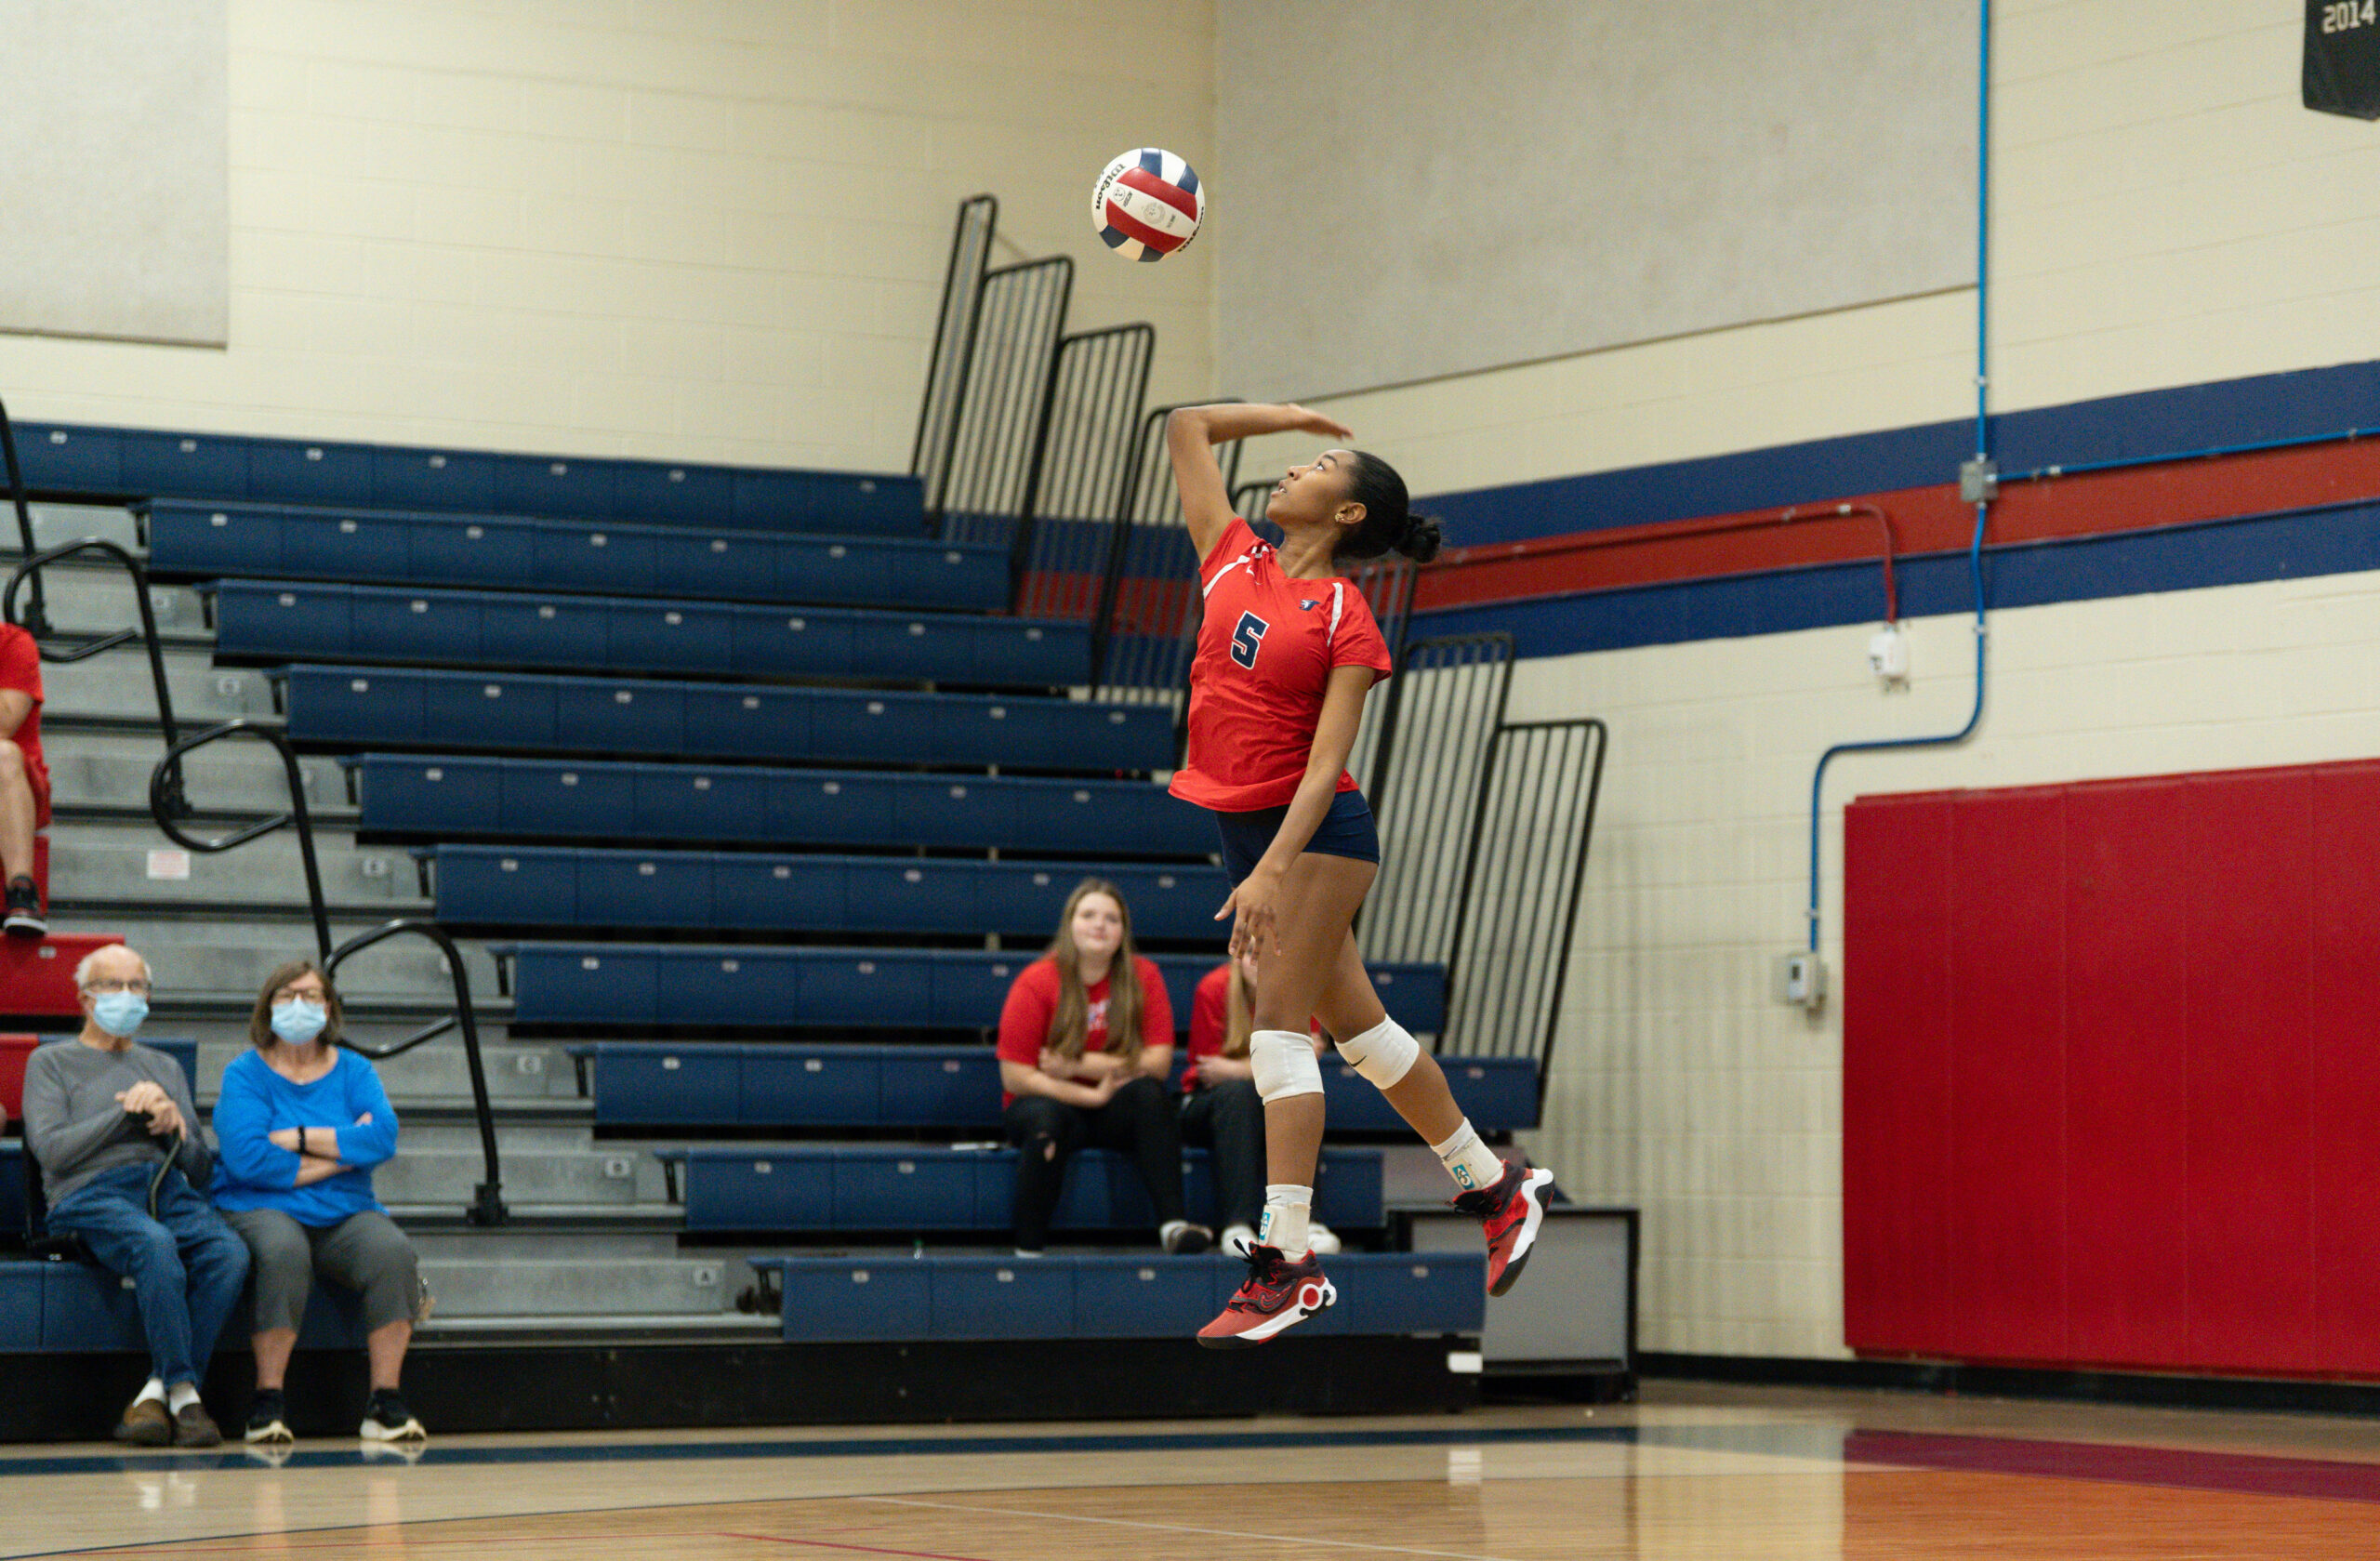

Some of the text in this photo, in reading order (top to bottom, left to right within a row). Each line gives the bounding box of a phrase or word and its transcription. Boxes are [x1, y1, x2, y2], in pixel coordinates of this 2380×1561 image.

[2322, 0, 2376, 33] 2014
[1095, 163, 1126, 210] Wilson
[1230, 610, 1270, 670] 5
